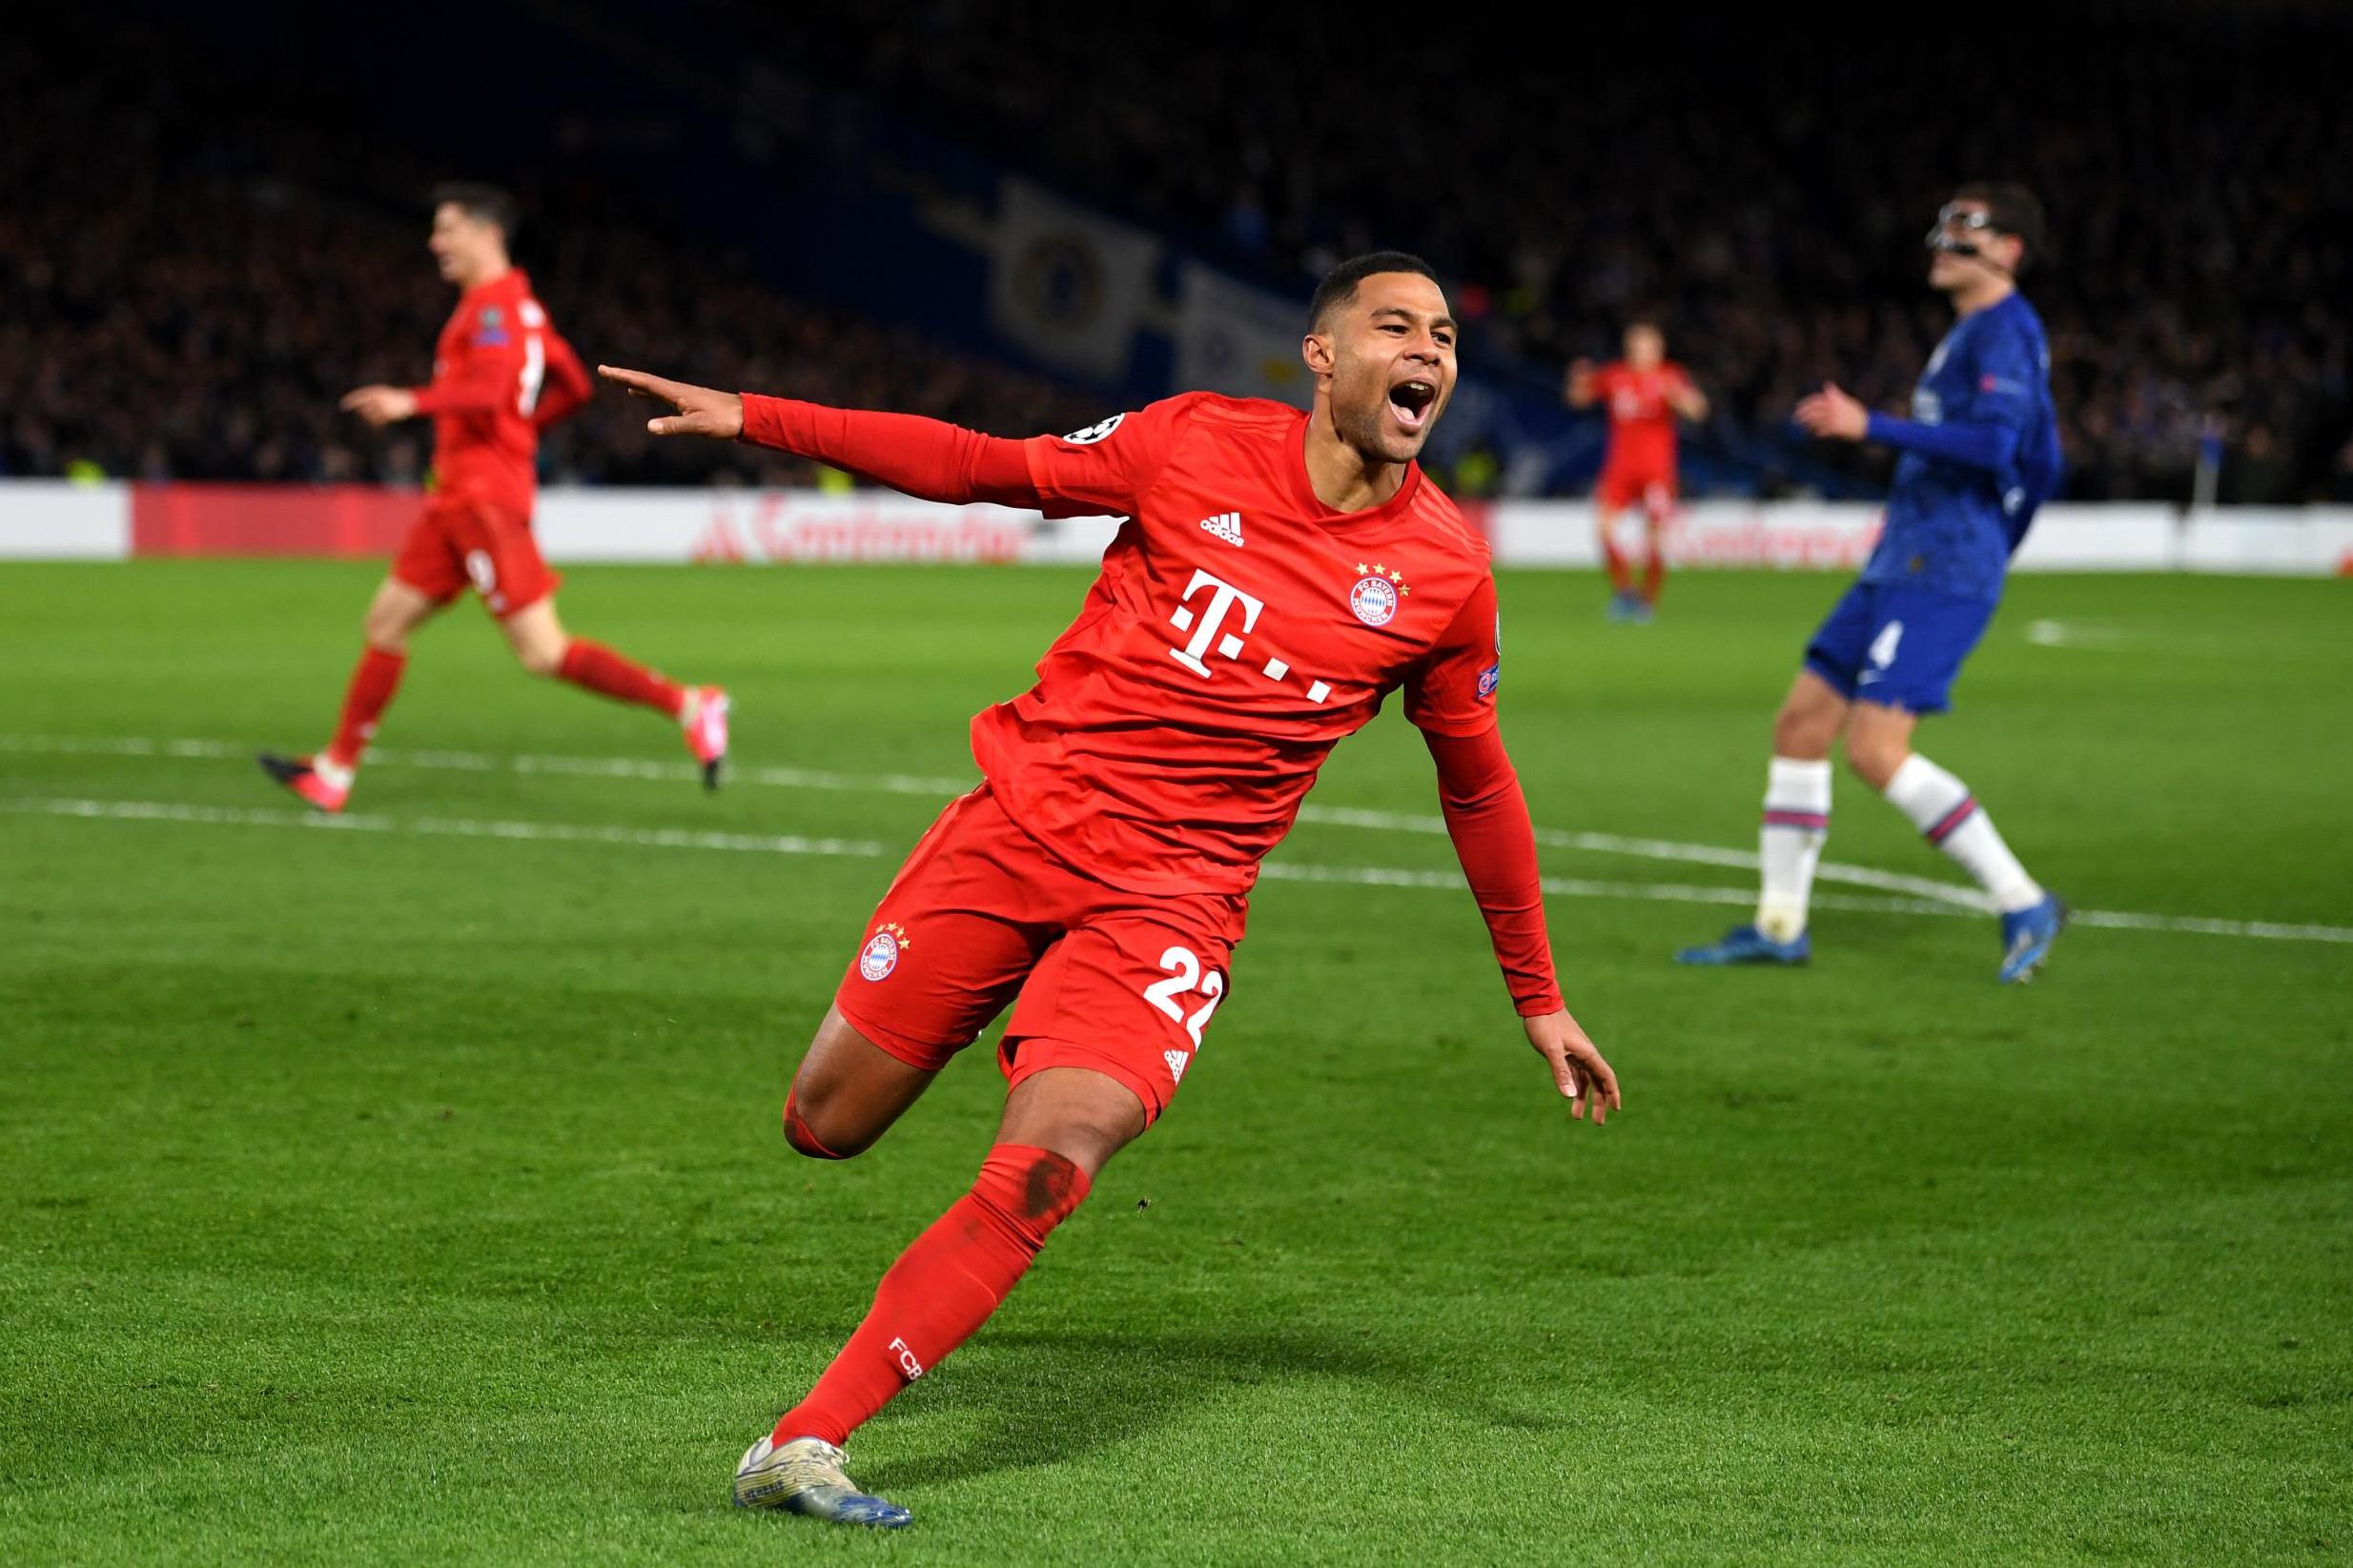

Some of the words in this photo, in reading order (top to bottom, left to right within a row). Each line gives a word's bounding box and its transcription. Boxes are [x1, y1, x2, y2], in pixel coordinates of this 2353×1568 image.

[1200, 519, 1244, 548] adidas
[1358, 581, 1370, 592] FC
[1370, 580, 1394, 607] BAYERN
[1169, 568, 1264, 679] T
[1870, 620, 1904, 669] 4
[1143, 946, 1224, 1052] 22
[888, 1336, 923, 1380] FCB
